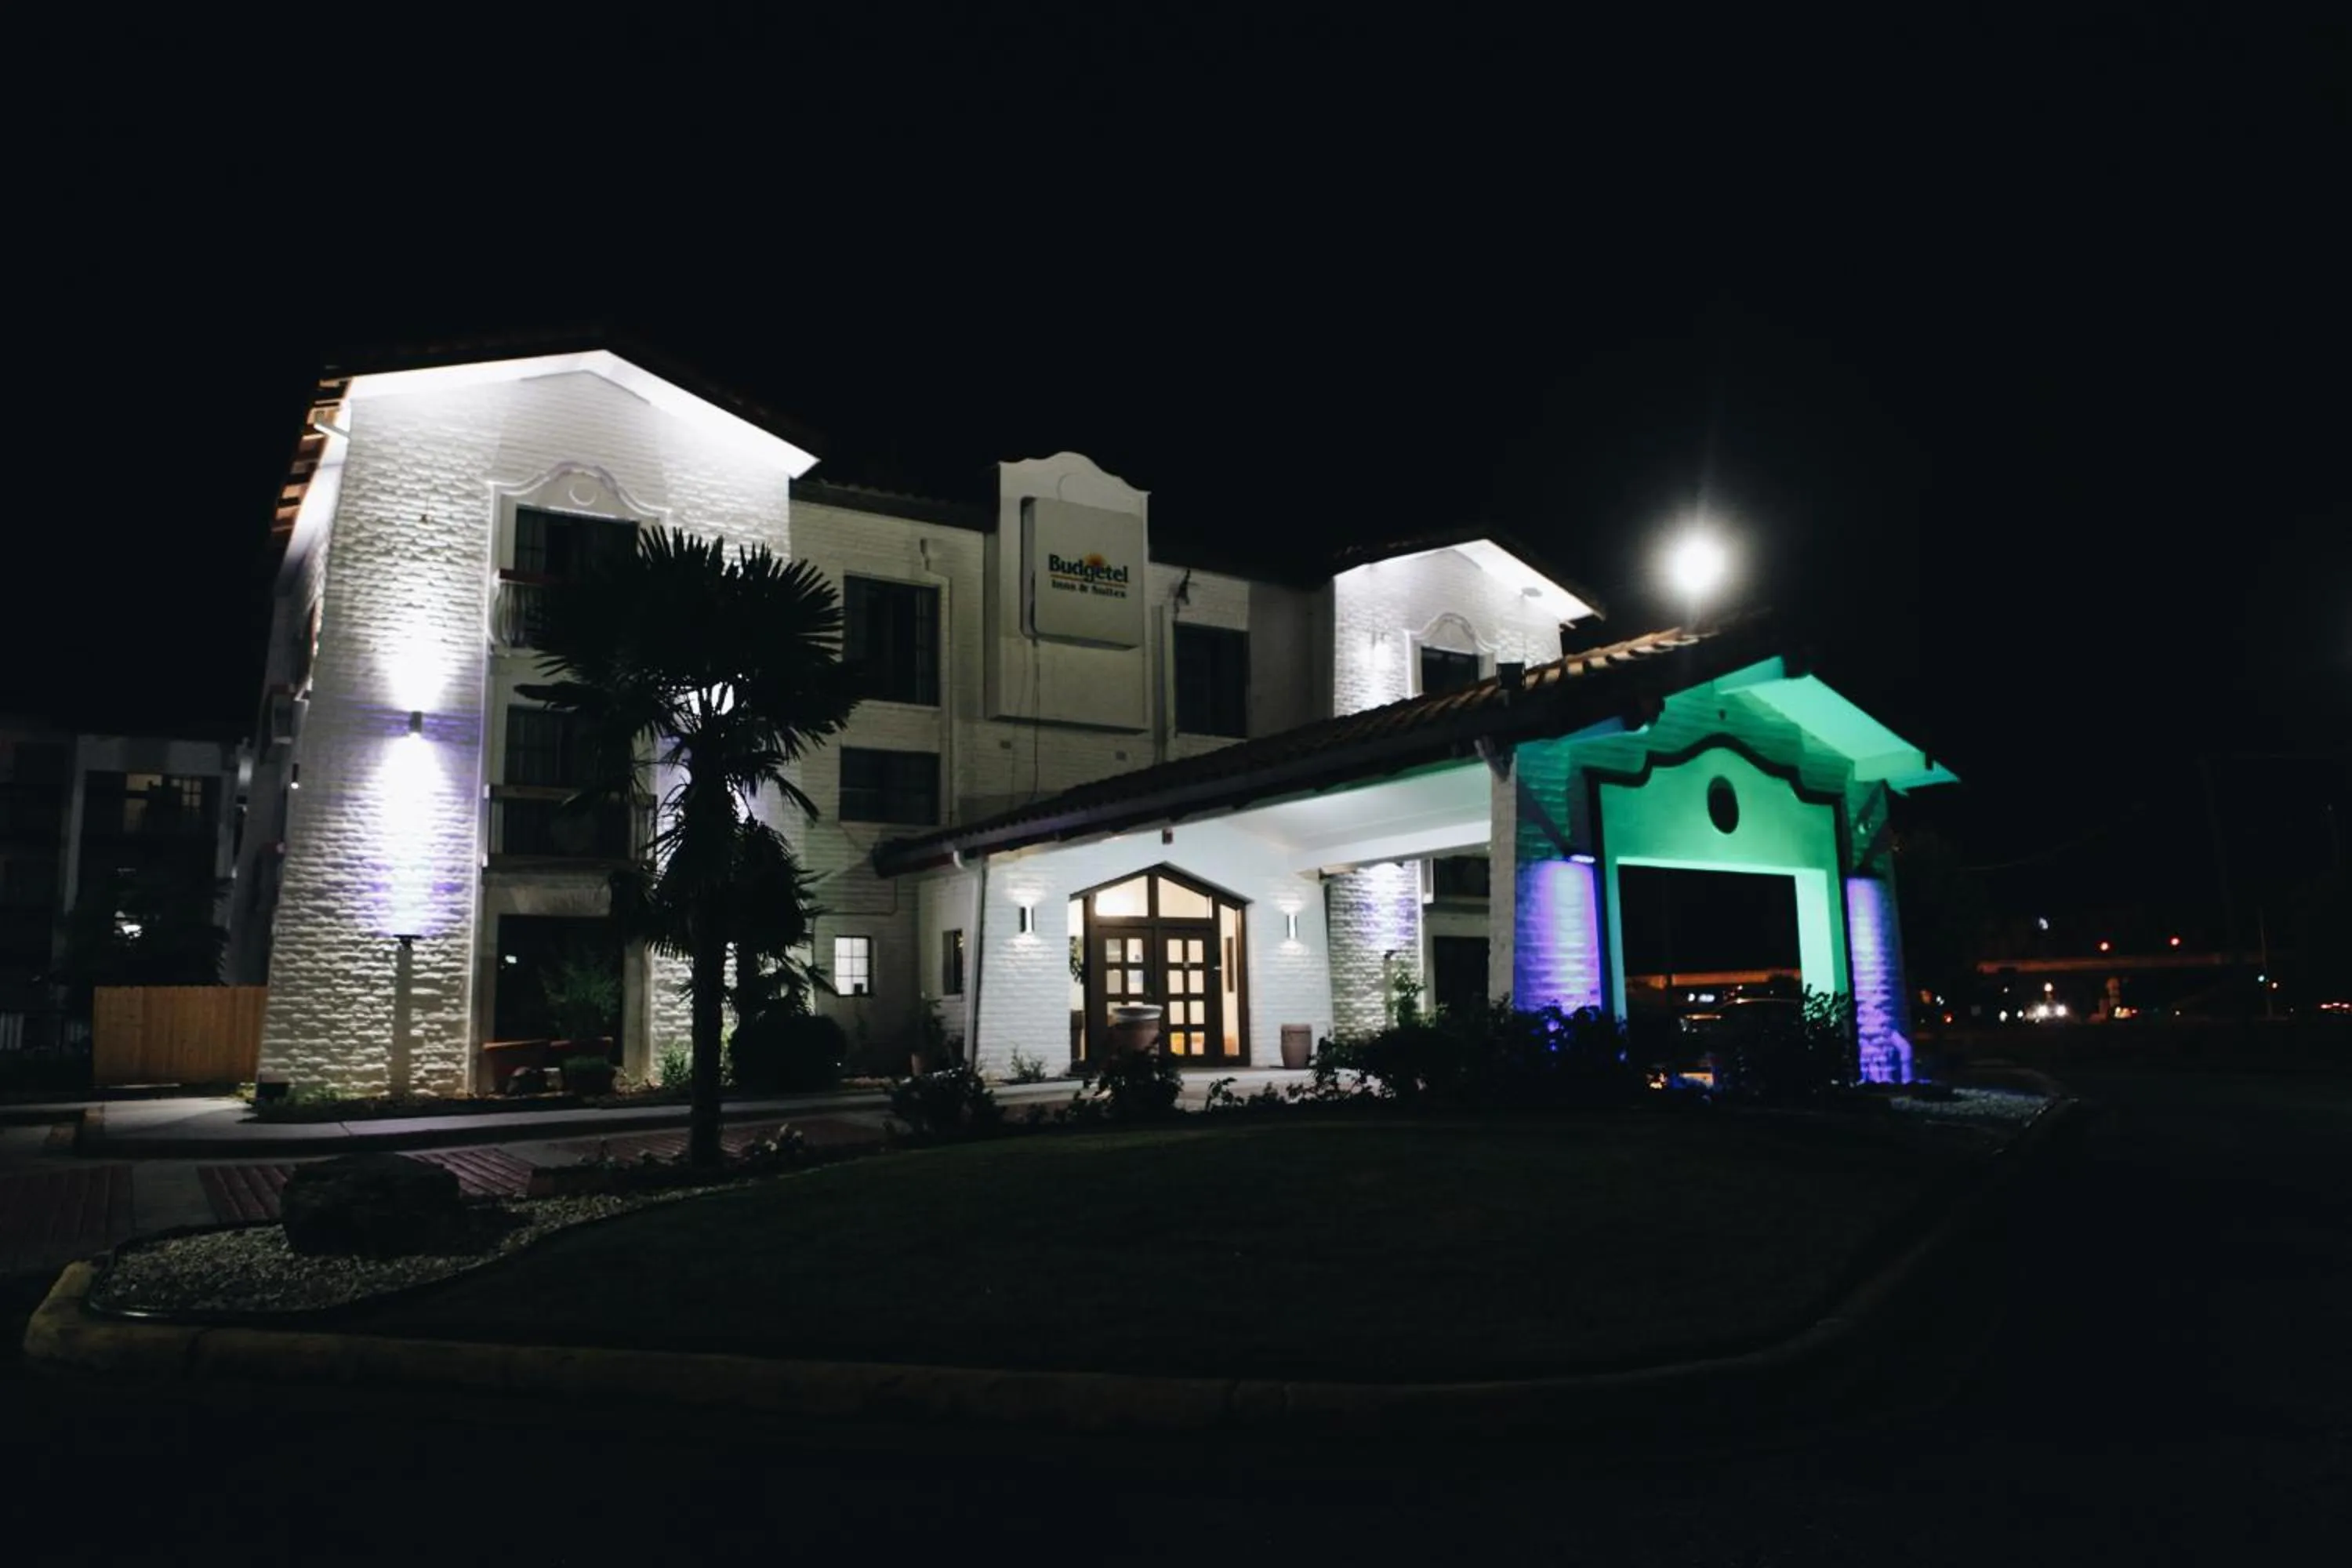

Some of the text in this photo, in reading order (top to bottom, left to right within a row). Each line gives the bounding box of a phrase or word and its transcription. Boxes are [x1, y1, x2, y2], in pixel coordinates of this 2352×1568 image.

[1049, 554, 1128, 583] Budgetel
[1080, 584, 1088, 593] &
[1091, 586, 1127, 599] Suites
